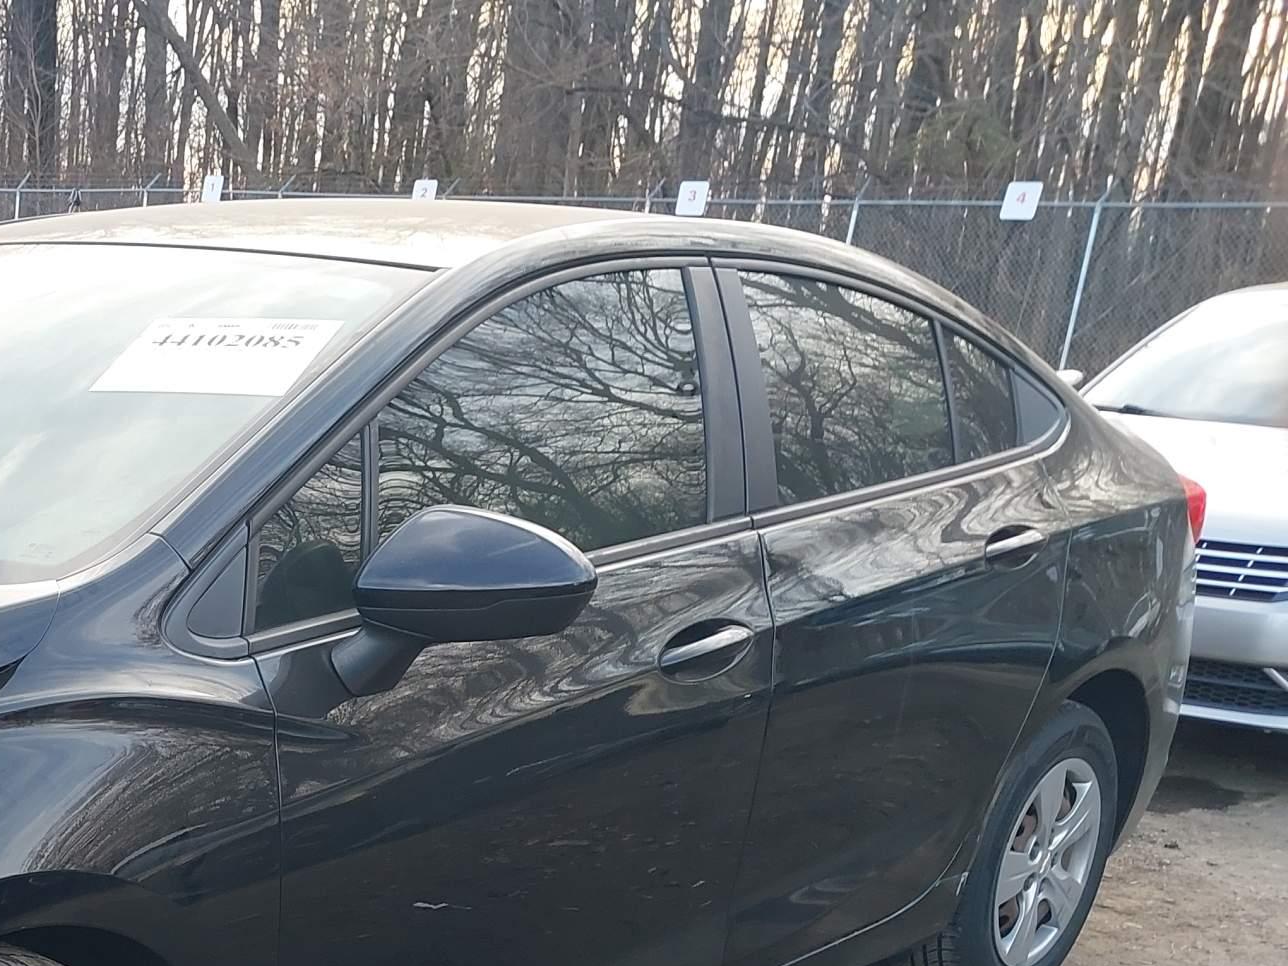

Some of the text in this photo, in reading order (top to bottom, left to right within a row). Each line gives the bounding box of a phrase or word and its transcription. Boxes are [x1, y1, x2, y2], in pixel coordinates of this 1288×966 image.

[688, 190, 697, 201] 3
[1016, 191, 1026, 204] 4
[151, 334, 305, 349] 44102085
